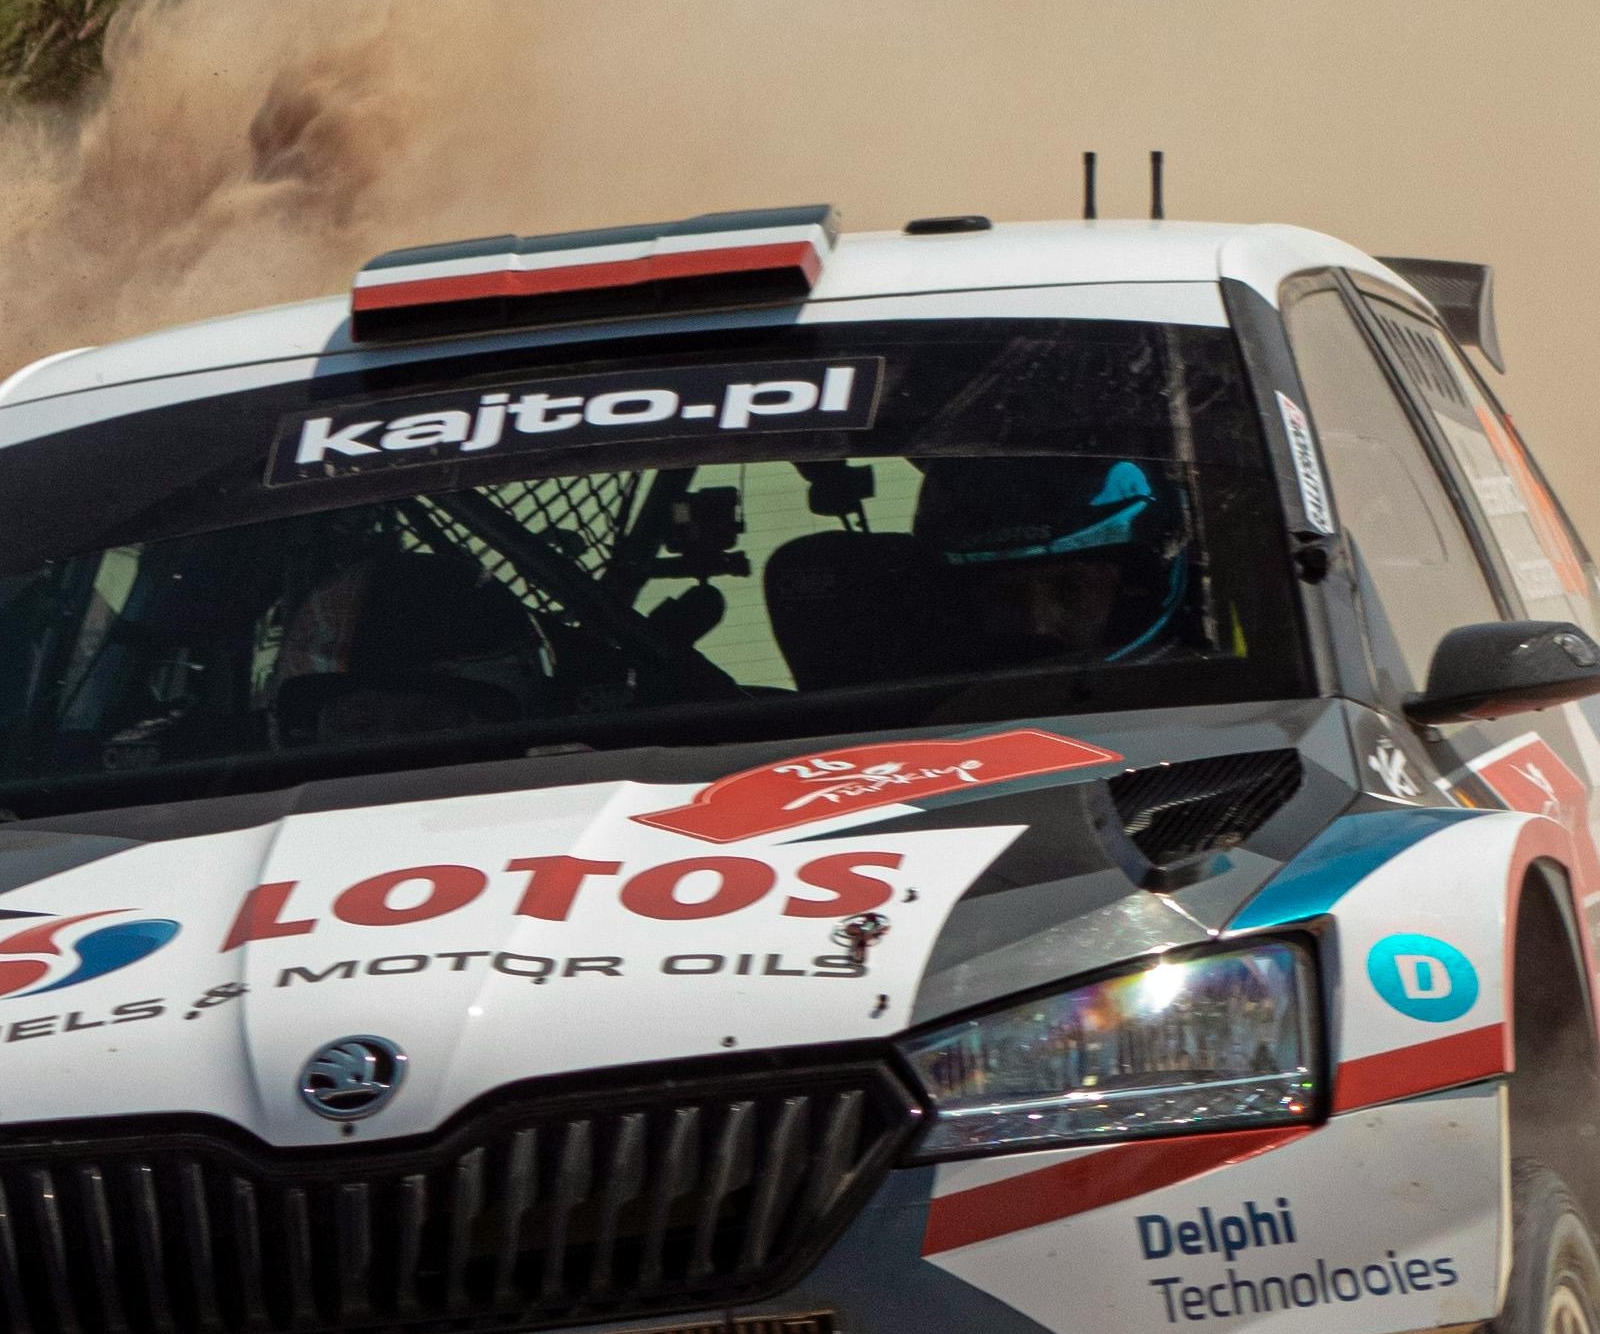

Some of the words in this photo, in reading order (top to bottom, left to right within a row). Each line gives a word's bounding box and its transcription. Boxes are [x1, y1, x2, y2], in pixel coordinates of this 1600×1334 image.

[295, 367, 856, 464] kajto.pl
[773, 759, 856, 778] 26
[220, 851, 905, 953] LOTOS
[193, 981, 249, 1008] &
[276, 950, 624, 987] MOTOR
[660, 953, 871, 978] OILS
[1393, 954, 1452, 999] D
[1134, 1197, 1298, 1262] Delphi
